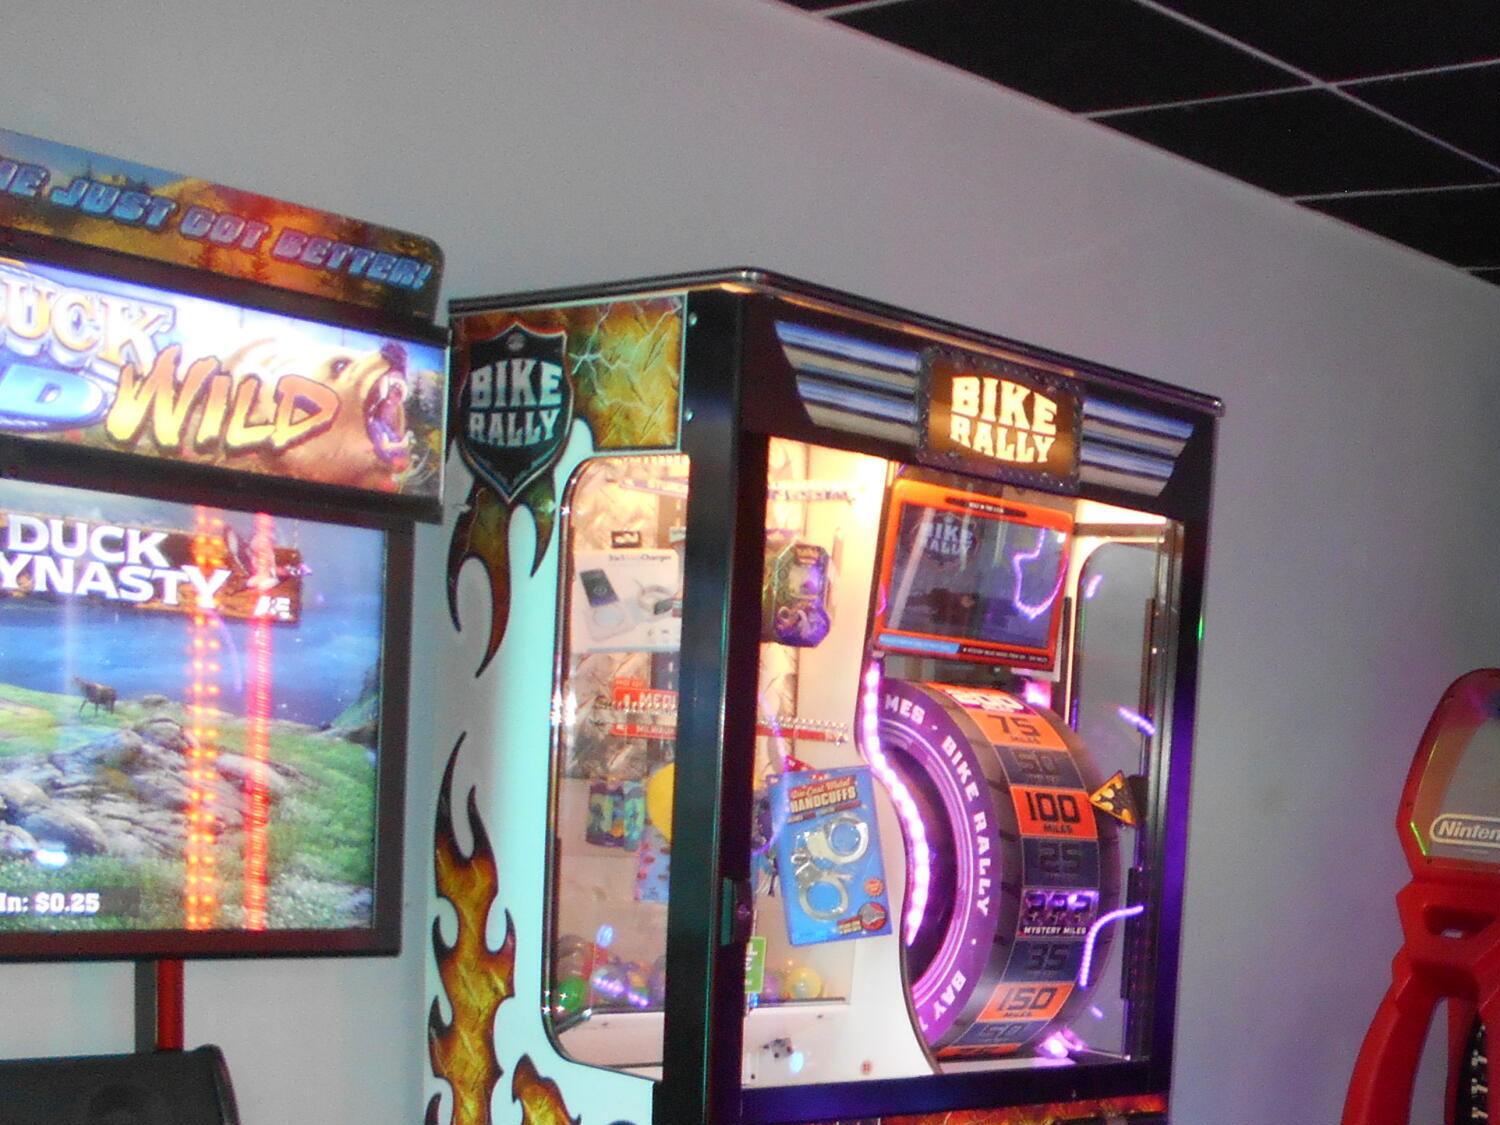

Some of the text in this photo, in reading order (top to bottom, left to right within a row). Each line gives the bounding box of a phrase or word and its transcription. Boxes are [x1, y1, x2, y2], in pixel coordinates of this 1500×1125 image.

[50, 177, 178, 229] JUST
[180, 205, 270, 250] GOT
[271, 229, 433, 289] BETTER!
[0, 280, 178, 378] UCK
[105, 342, 340, 450] WILD
[469, 357, 563, 408] BIKE
[950, 374, 1058, 437] BIKE
[468, 408, 561, 448] RALLY
[949, 412, 1056, 465] RALLY
[8, 514, 169, 568] DUCK
[0, 551, 231, 610] YNASTY
[987, 714, 1041, 737] 75
[790, 786, 857, 813] HANDCUFFS
[1025, 791, 1081, 823] 100
[941, 735, 980, 802] BIKE
[972, 811, 992, 917] RALLY
[34, 891, 100, 914] $0.25
[1023, 925, 1087, 935] MYSTERY MILES
[996, 986, 1058, 1012] 150
